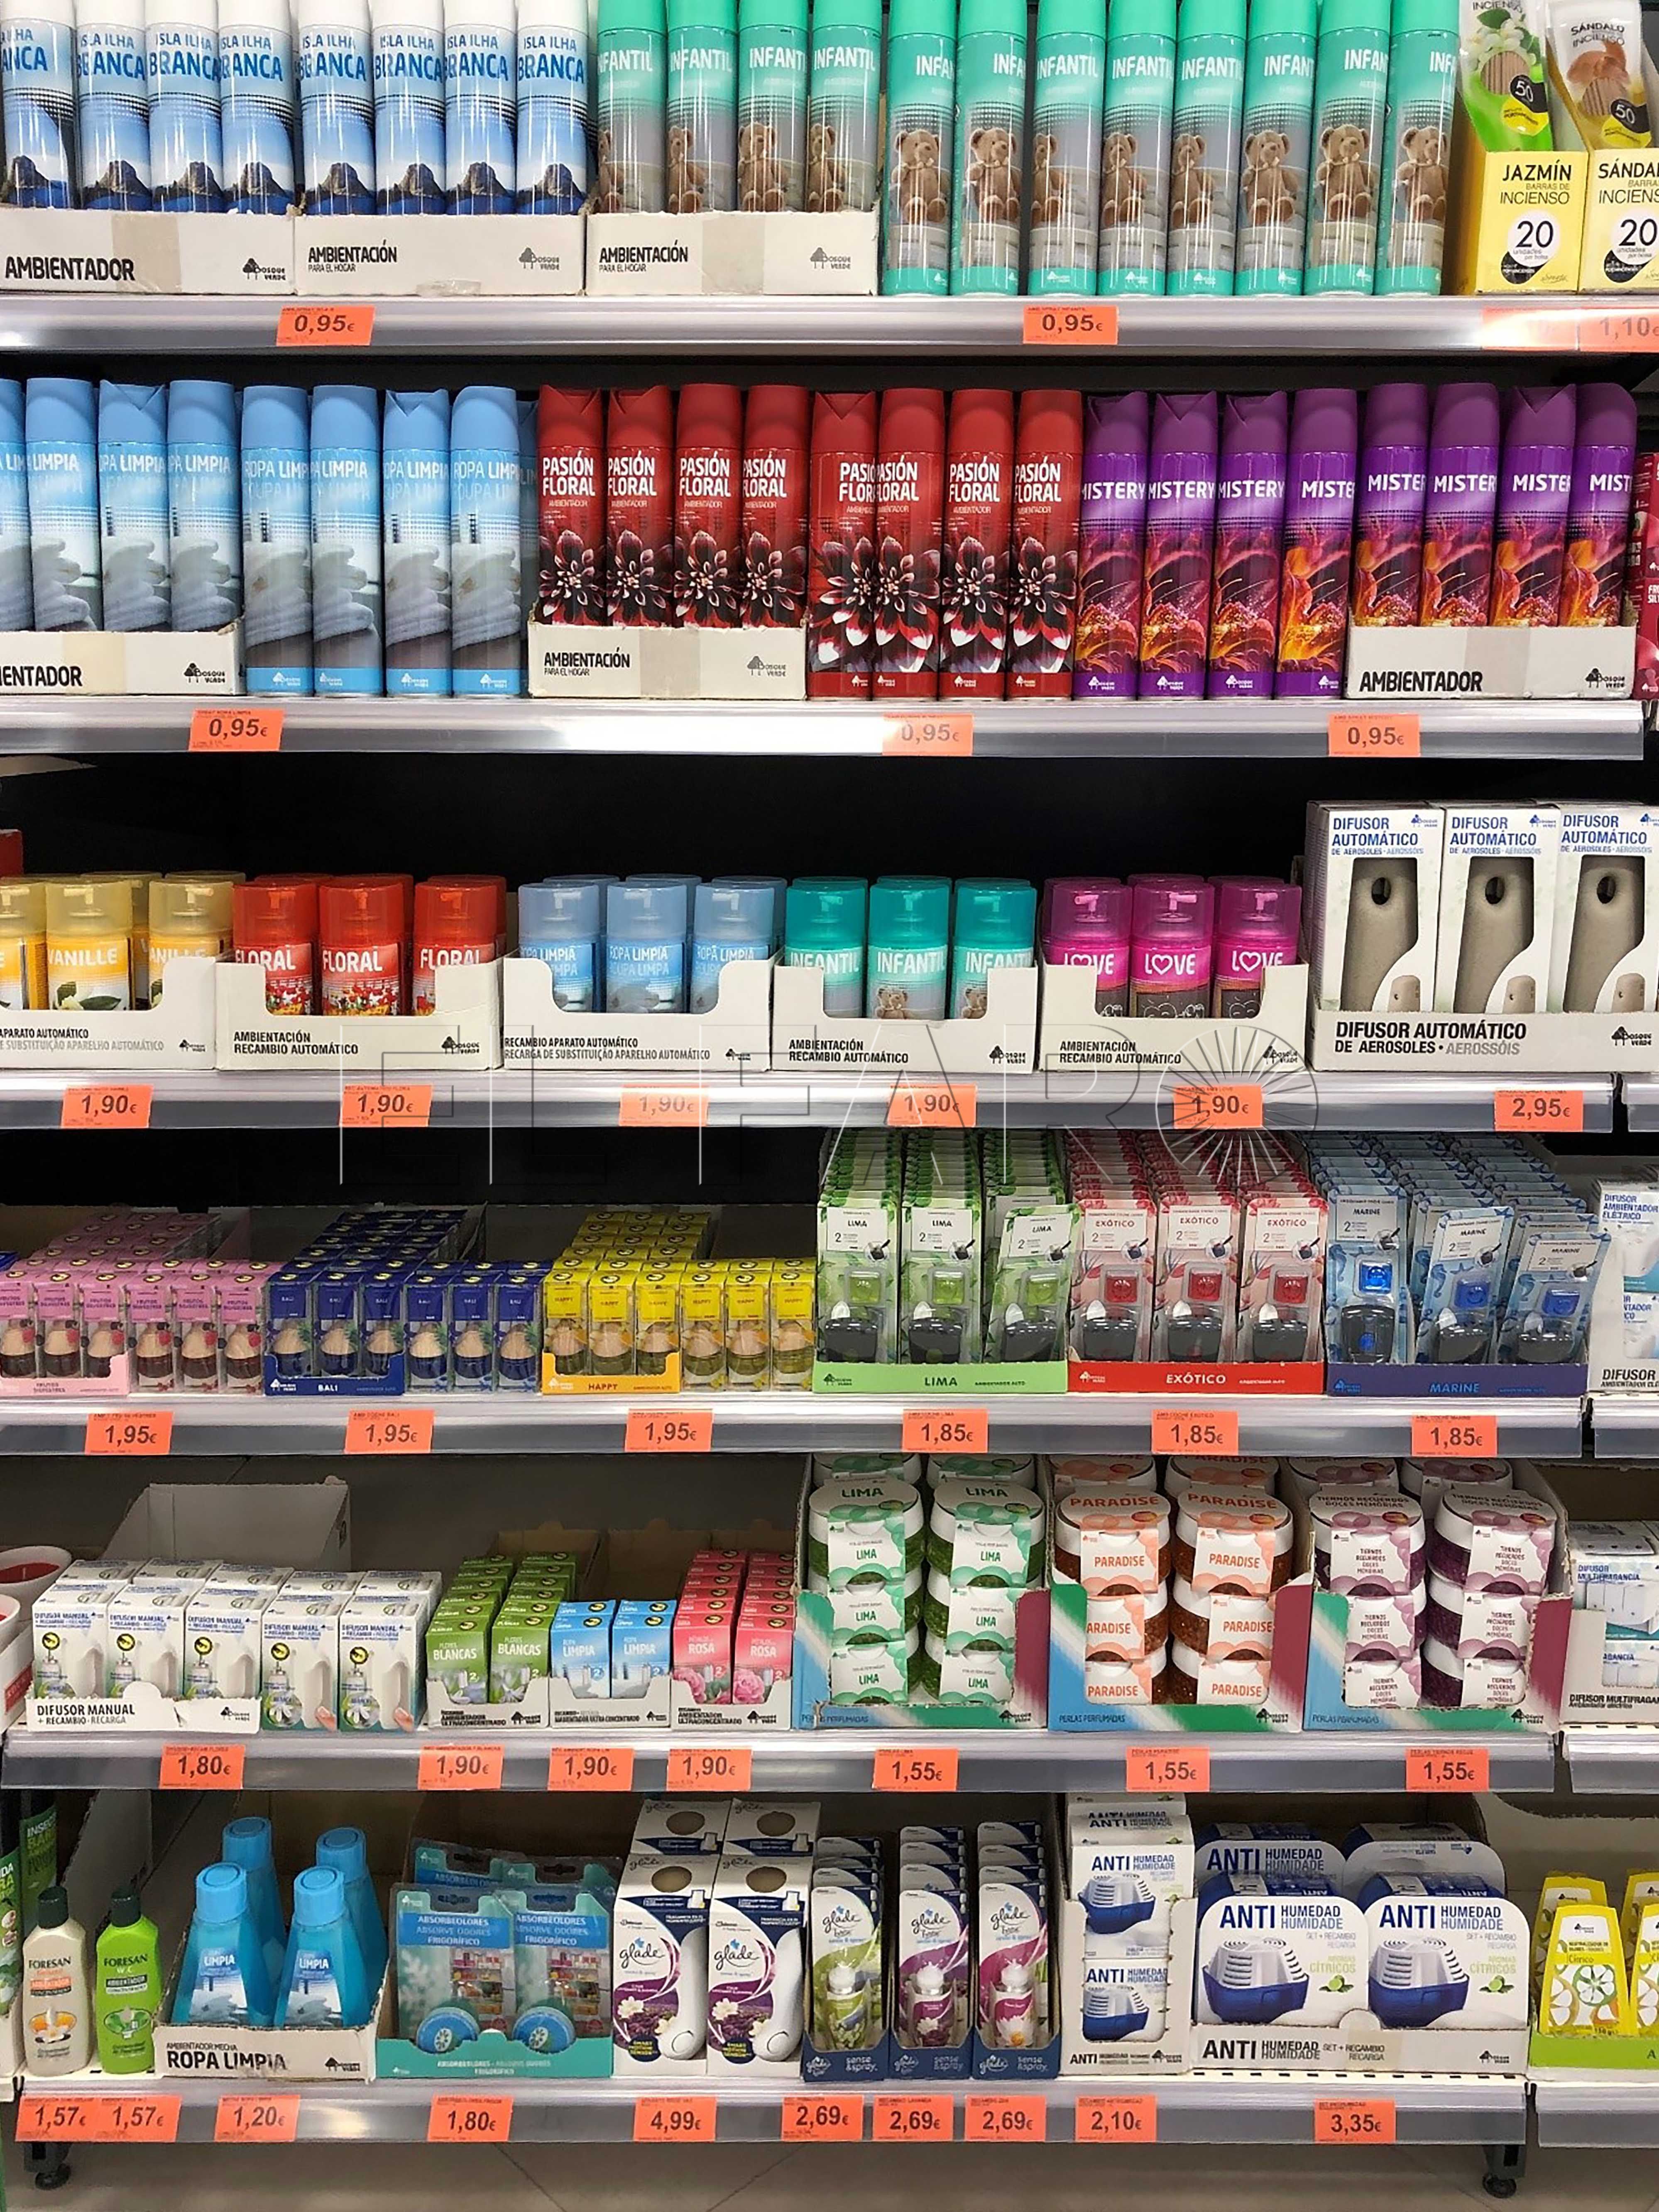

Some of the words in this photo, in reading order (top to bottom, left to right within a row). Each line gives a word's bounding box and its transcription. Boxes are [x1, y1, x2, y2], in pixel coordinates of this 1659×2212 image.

[1571, 23, 1624, 35] SÁNDALO
[470, 34, 497, 49] ILHA
[524, 37, 546, 50] ISLA
[550, 37, 576, 51] ILHA
[1572, 37, 1625, 47] INCIENSO
[518, 54, 583, 82] BRANCA
[814, 47, 875, 71] INFANTIL
[1515, 81, 1534, 102] 50
[1615, 105, 1636, 125] 50
[1502, 159, 1572, 181] JAZMÍN
[1500, 191, 1569, 204] INCIENSO
[1516, 220, 1554, 247] 20
[1619, 219, 1657, 246] 20
[599, 240, 688, 263] AMBIENTACIÓN
[5, 256, 135, 281] AMBIENTADOR
[308, 264, 324, 272] PARA
[326, 264, 333, 272] EL
[334, 263, 356, 272] HOGAR
[294, 314, 355, 335] 0,95€
[1042, 314, 1103, 334] 0,95€
[186, 455, 230, 473] LIMPIA
[454, 462, 485, 479] ROPA
[543, 452, 594, 476] PASIÓN
[680, 452, 730, 477] PASIÓN
[543, 477, 595, 496] FLORAL
[680, 478, 731, 498] FLORAL
[1148, 481, 1215, 500] MISTERY
[544, 647, 630, 668] AMBIENTACIÓN
[1359, 671, 1483, 692] AMBIENTADOR
[208, 719, 268, 738] 0,95€
[901, 723, 959, 743] 0,95€
[1347, 726, 1404, 746] 0,95€
[1451, 816, 1508, 829] DIFUSOR
[1563, 815, 1619, 828] DIFUSOR
[1450, 829, 1537, 846] AUTOMÁTICO
[1561, 829, 1647, 845] AUTOMÁTICO
[48, 948, 117, 966] VANILLE
[632, 947, 668, 961] LIMPIA
[878, 952, 945, 973] INFANTIL
[37, 1028, 88, 1039] AUTOMÁTICO
[1336, 1022, 1409, 1039] DIFUSOR
[1414, 1019, 1526, 1039] AUTOMÁTICO
[6, 1039, 65, 1053] SUBSTITUIÇÃO
[67, 1040, 110, 1051] APARELHO
[112, 1039, 164, 1051] AUTOMÁTICO
[234, 1043, 287, 1055] RECAMBIO
[291, 1041, 358, 1055] AUTOMÁTICO
[505, 1038, 546, 1048] RECAMBIO
[549, 1038, 585, 1048] APARATO
[587, 1036, 638, 1048] AUTOMÁTICO
[1335, 1040, 1352, 1053] DE
[1359, 1041, 1436, 1054] AEROSOLES
[1445, 1041, 1520, 1055] AEROSSÓIS
[505, 1049, 541, 1059] RECARGA
[543, 1049, 553, 1059] DE
[555, 1047, 613, 1061] SUBSTITUIÇÃO
[615, 1049, 657, 1059] APARELHO
[659, 1047, 710, 1060] AUTOMÁTICO
[789, 1052, 841, 1063] RECAMBIO
[844, 1051, 908, 1063] AUTOMÁTICO
[1060, 1053, 1112, 1064] RECAMBIO
[1115, 1051, 1181, 1064] AUTOMÁTICO
[81, 1094, 136, 1115] 1,90€
[357, 1094, 413, 1115] 1,90€
[639, 1095, 693, 1115] 1,90€
[904, 1093, 959, 1114] 1,90€
[1191, 1095, 1249, 1116] 1,90€
[1512, 1097, 1570, 1119] 2,95€
[1180, 1216, 1219, 1225] EXÓTICO
[1603, 1210, 1641, 1220] ELÉCTRICO
[925, 1377, 957, 1386] LIMA
[1166, 1371, 1226, 1384] EXÓTICO
[1430, 1383, 1480, 1393] MARINE
[105, 1425, 157, 1447] 1,95€
[365, 1424, 417, 1445] 1,95€
[644, 1423, 696, 1444] 1,95€
[921, 1423, 974, 1445] 1,85€
[1172, 1425, 1223, 1445] 1,85€
[1430, 1428, 1482, 1448] 1,85€
[965, 1487, 1008, 1498] LIMA
[1094, 1555, 1145, 1567] PARADISE
[1209, 1553, 1260, 1568] PARADISE
[433, 1648, 477, 1660] BLANCAS
[498, 1643, 541, 1656] BLANCAS
[689, 1643, 714, 1653] ROSA
[750, 1645, 776, 1657] ROSA
[37, 1705, 84, 1716] DIFUSOR
[88, 1704, 135, 1715] MANUAL
[46, 1717, 86, 1725] RECAMBIO
[91, 1715, 126, 1724] RECARGA
[178, 1756, 230, 1778] 1,80€
[437, 1756, 488, 1777] 1,90€
[565, 1757, 617, 1779] 1,90€
[683, 1757, 735, 1779] 1,90€
[892, 1762, 942, 1783] 1,55€
[1145, 1762, 1197, 1782] 1,55€
[1424, 1762, 1474, 1782] 1,55€
[1091, 1856, 1130, 1871] ANTI
[1133, 1854, 1175, 1863] HUMEDAD
[1220, 1905, 1275, 1929] ANTI
[1281, 1905, 1341, 1917] HUMEDAD
[1281, 1917, 1343, 1929] HUMIDADE
[1380, 1904, 1435, 1929] ANTI
[1441, 1906, 1501, 1918] HUMEDAD
[1441, 1918, 1503, 1931] HUMIDADE
[29, 1956, 71, 1969] FORESAN
[104, 1954, 148, 1966] FORESAN
[299, 1958, 329, 1969] LIMPIA
[619, 1944, 664, 1968] glade
[714, 1944, 759, 1968] glade
[1203, 2040, 1256, 2059] ANTI
[1261, 2040, 1319, 2050] HUMEDAD
[1345, 2044, 1385, 2053] RECAMBIO
[1348, 2053, 1384, 2061] RECARGA
[168, 2051, 219, 2069] ROPA
[34, 2107, 86, 2129] 1,57€
[113, 2107, 163, 2129] 1,57€
[234, 2106, 284, 2129] 1,20€
[447, 2111, 495, 2132] 1,80€
[651, 2111, 700, 2132] 4,99€
[796, 2106, 848, 2126] 2,69€
[890, 2111, 940, 2132] 2,69€
[982, 2111, 1032, 2132] 2,69€
[1091, 2112, 1141, 2134] 2,10€
[1331, 2114, 1381, 2135] 3,35€
